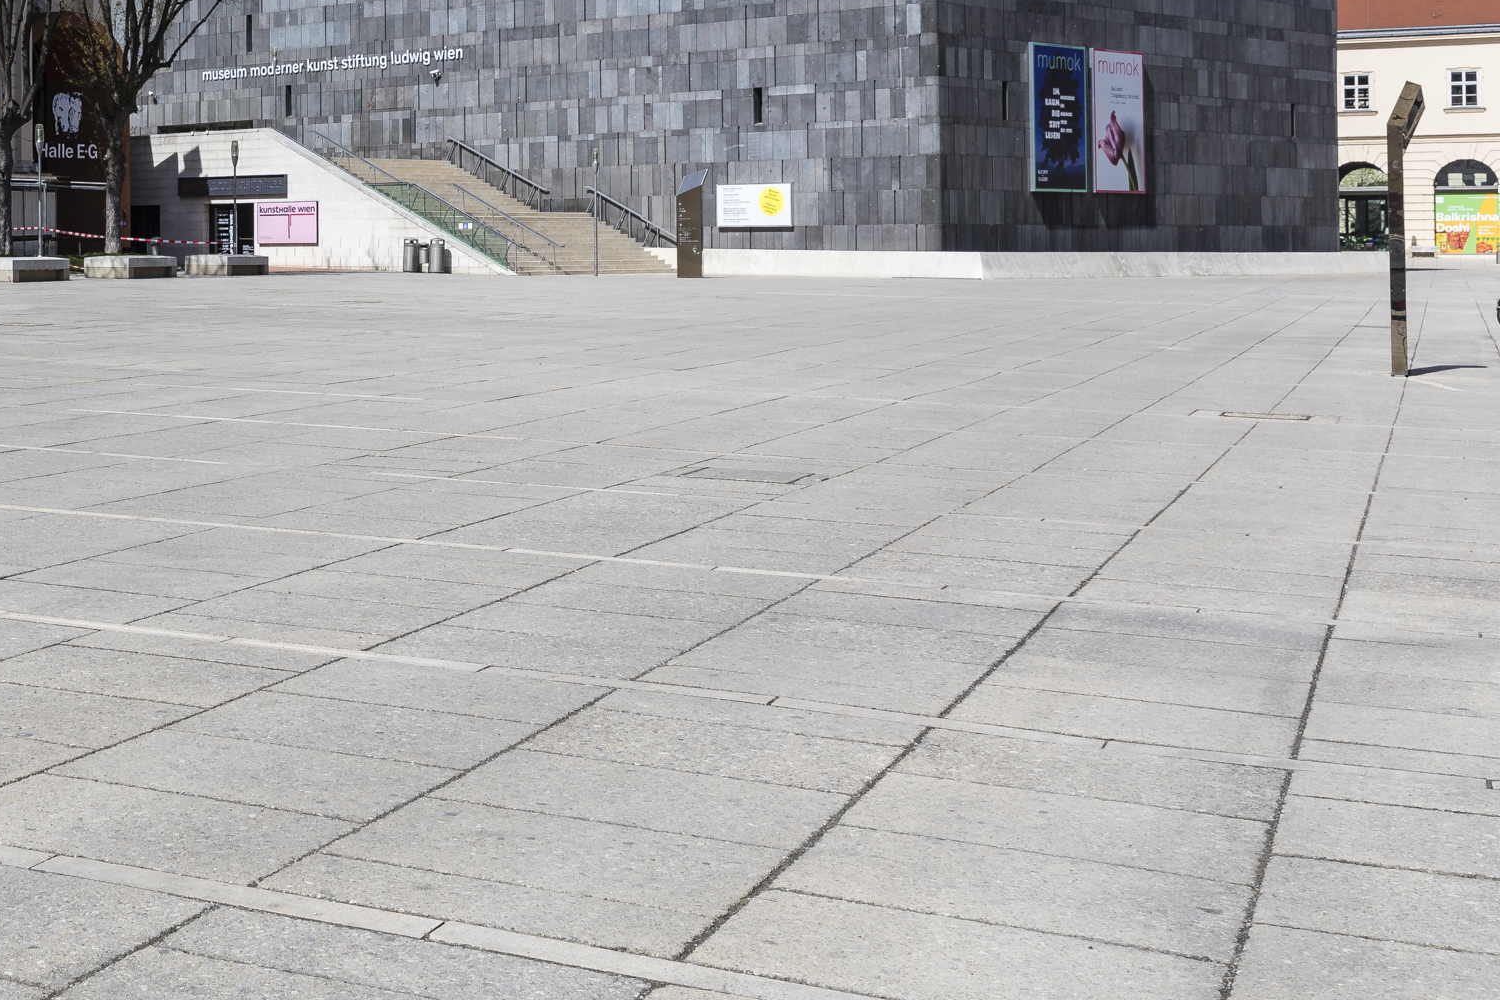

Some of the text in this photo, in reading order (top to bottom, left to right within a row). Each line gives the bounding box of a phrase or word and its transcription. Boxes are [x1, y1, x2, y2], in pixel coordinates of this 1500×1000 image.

[202, 46, 463, 82] museum moderner kunst stiftung ludwig wien
[1037, 53, 1081, 72] mumok
[1098, 59, 1139, 76] mumok
[1436, 212, 1499, 222] Balkrishna
[1436, 222, 1470, 233] Doshi
